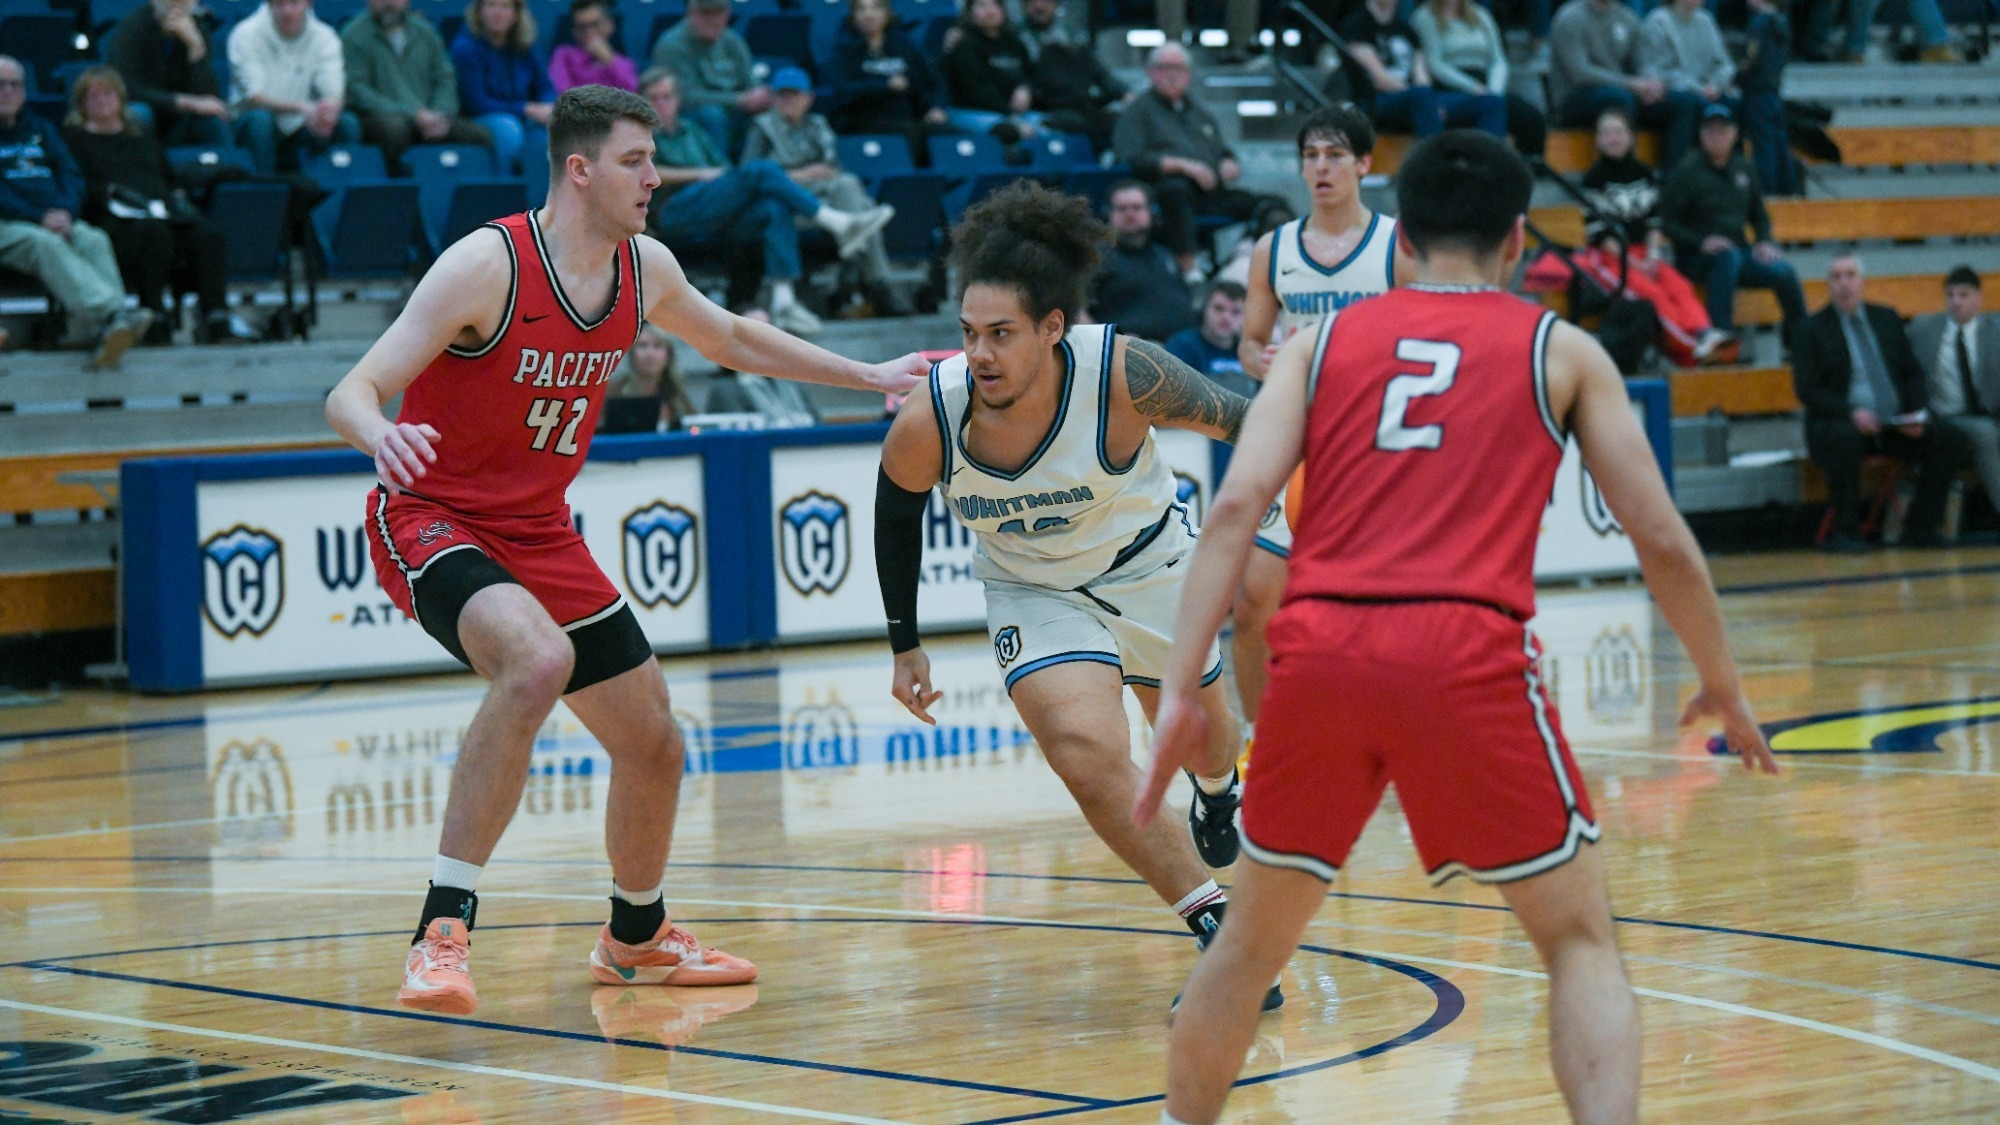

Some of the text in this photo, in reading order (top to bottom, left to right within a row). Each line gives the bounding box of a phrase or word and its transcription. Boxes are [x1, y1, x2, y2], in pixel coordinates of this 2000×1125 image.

[513, 347, 623, 388] PACIFIC
[1374, 337, 1462, 451] 2
[525, 396, 589, 457] 42
